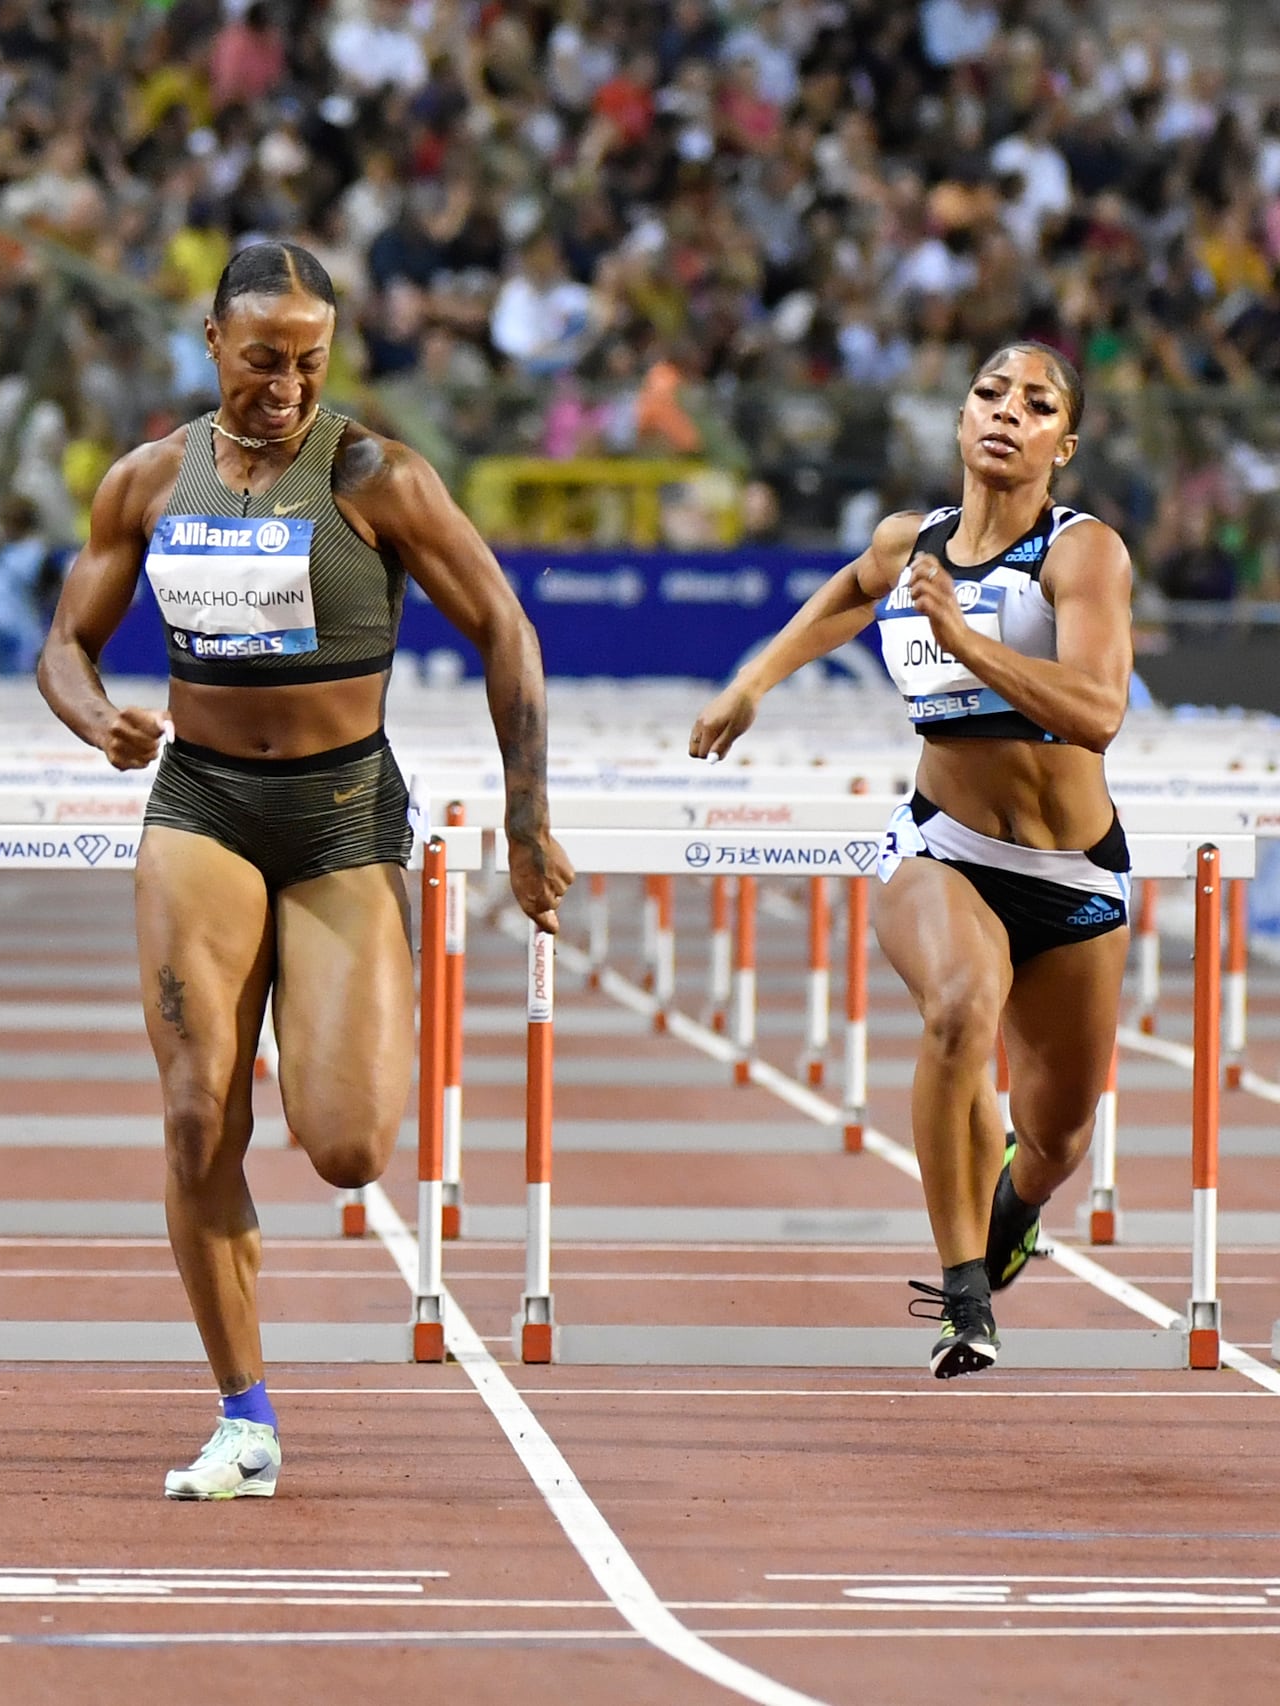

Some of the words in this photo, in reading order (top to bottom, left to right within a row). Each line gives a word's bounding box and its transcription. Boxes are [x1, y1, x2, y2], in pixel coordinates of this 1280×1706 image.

[170, 522, 252, 547] Allianz
[159, 588, 305, 608] CAMACHO-QUINN
[195, 637, 283, 656] BRUSSELS
[903, 639, 961, 666] JONE
[1066, 908, 1120, 925] adidas
[532, 939, 547, 1000] polanik
